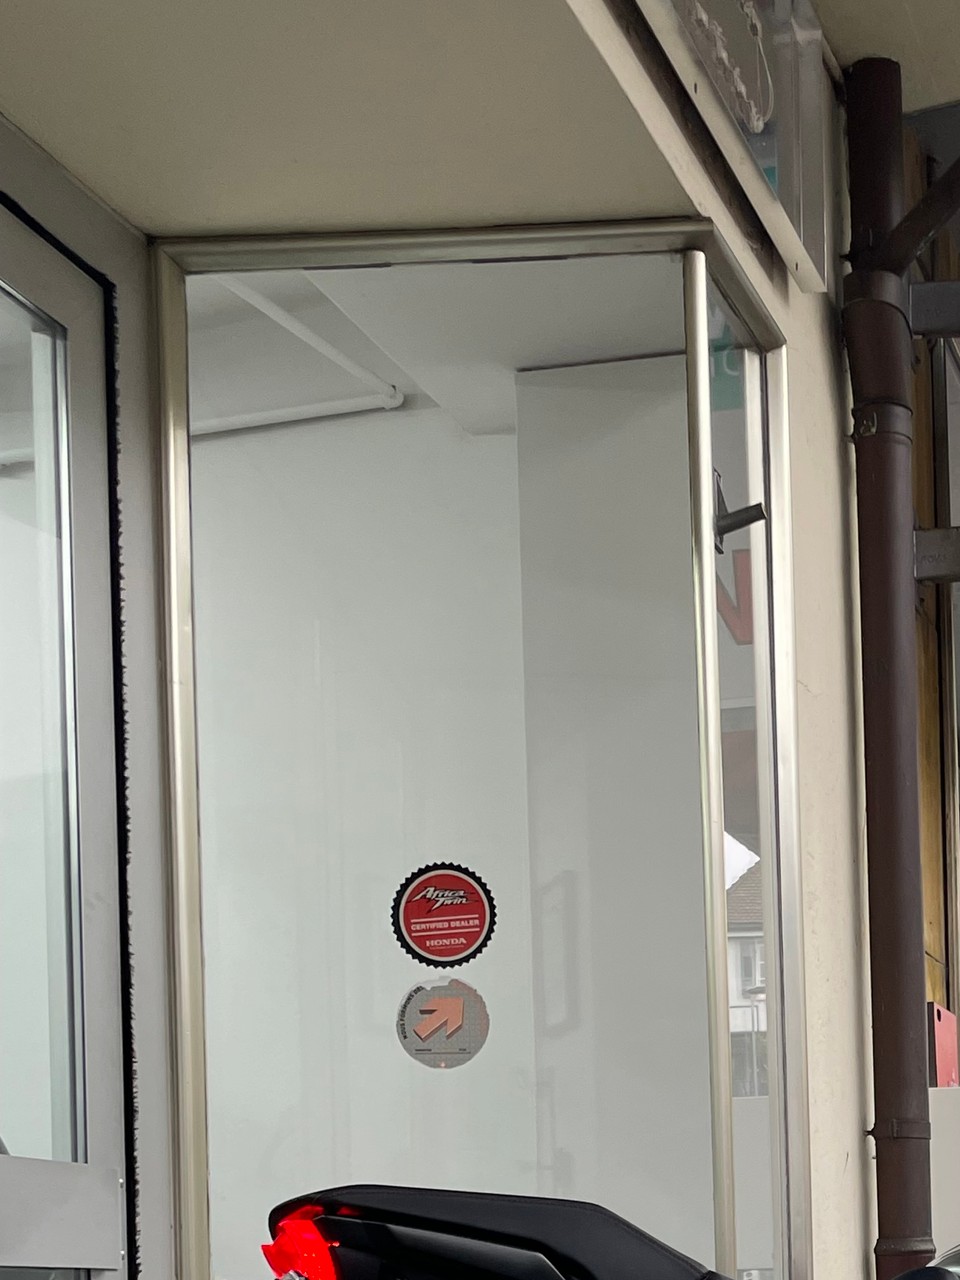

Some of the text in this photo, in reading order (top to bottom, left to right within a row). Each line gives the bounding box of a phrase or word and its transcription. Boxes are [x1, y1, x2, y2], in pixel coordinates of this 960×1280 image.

[411, 886, 467, 902] Africa
[431, 897, 469, 912] Twin
[411, 919, 480, 931] CERTIFIED DEALER
[425, 938, 467, 948] HONDA
